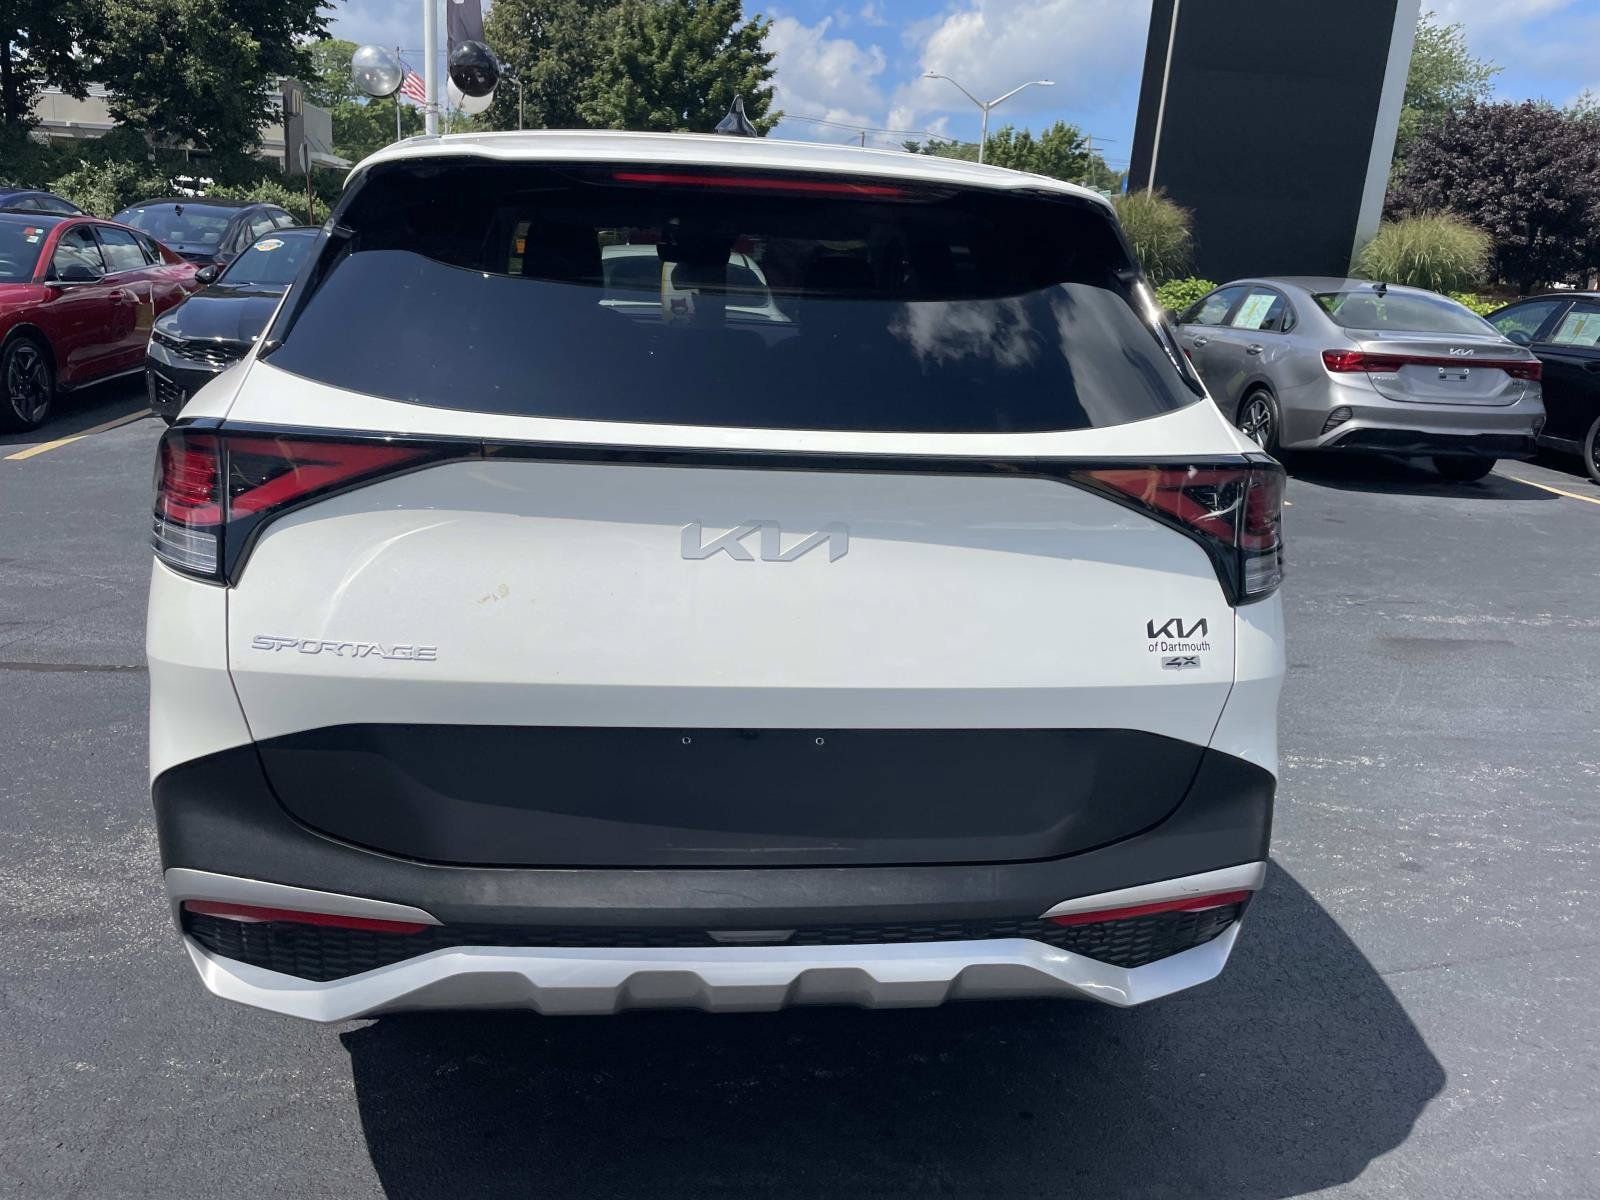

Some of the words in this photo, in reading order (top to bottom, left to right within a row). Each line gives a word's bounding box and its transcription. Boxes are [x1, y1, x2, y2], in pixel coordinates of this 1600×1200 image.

[680, 519, 849, 564] KIA
[1146, 617, 1208, 639] KIA
[251, 634, 438, 661] SPORTAGE
[1148, 641, 1159, 652] of
[1160, 641, 1211, 652] Dartmouth
